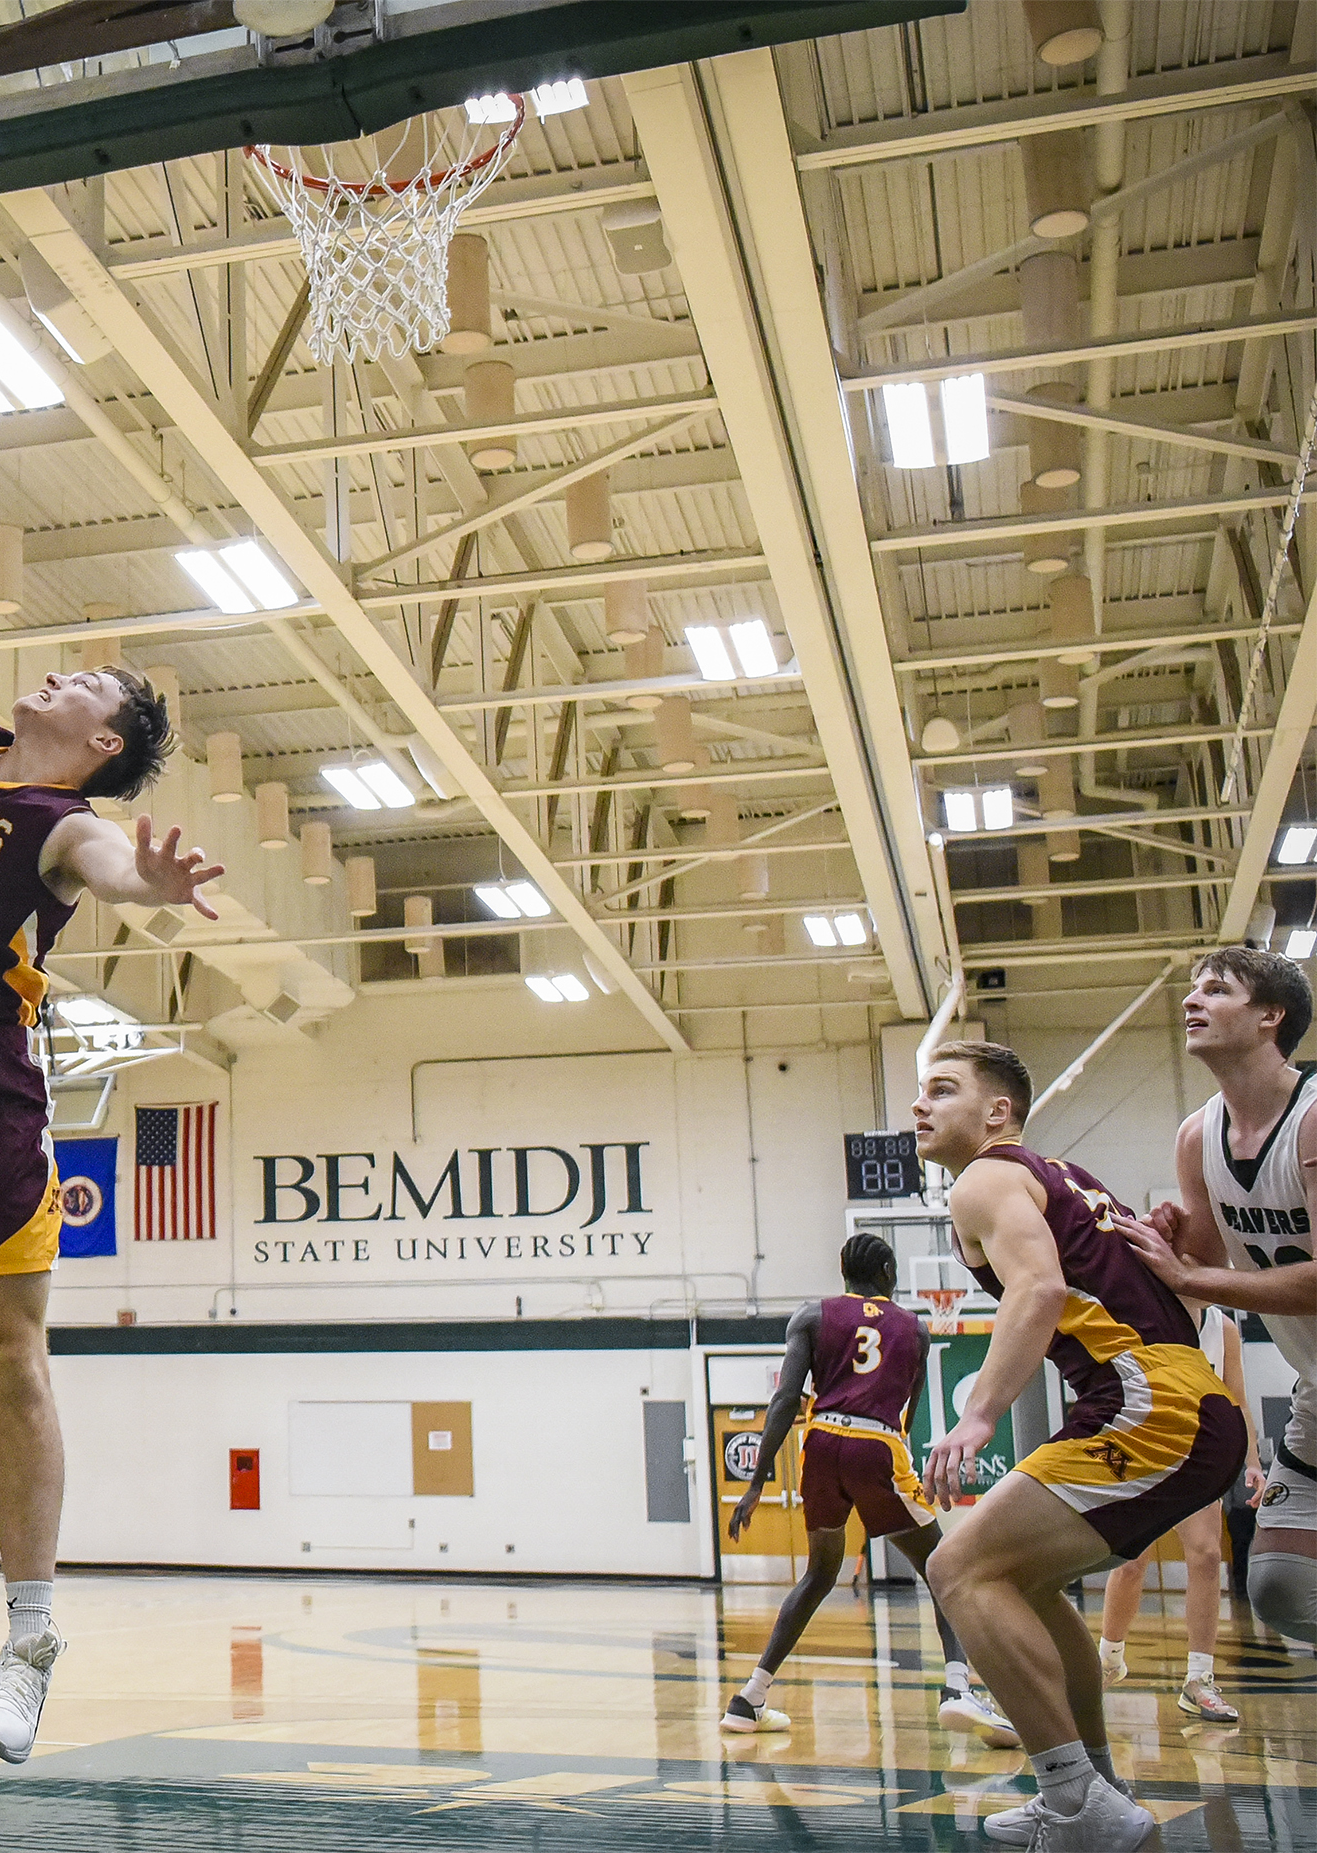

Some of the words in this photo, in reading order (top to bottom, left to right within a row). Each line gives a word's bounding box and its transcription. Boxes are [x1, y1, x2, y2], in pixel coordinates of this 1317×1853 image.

[253, 1141, 654, 1229] BEMIDJI
[253, 1238, 371, 1264] STATE
[393, 1231, 655, 1263] UNIVERSITY
[852, 1325, 883, 1375] 3
